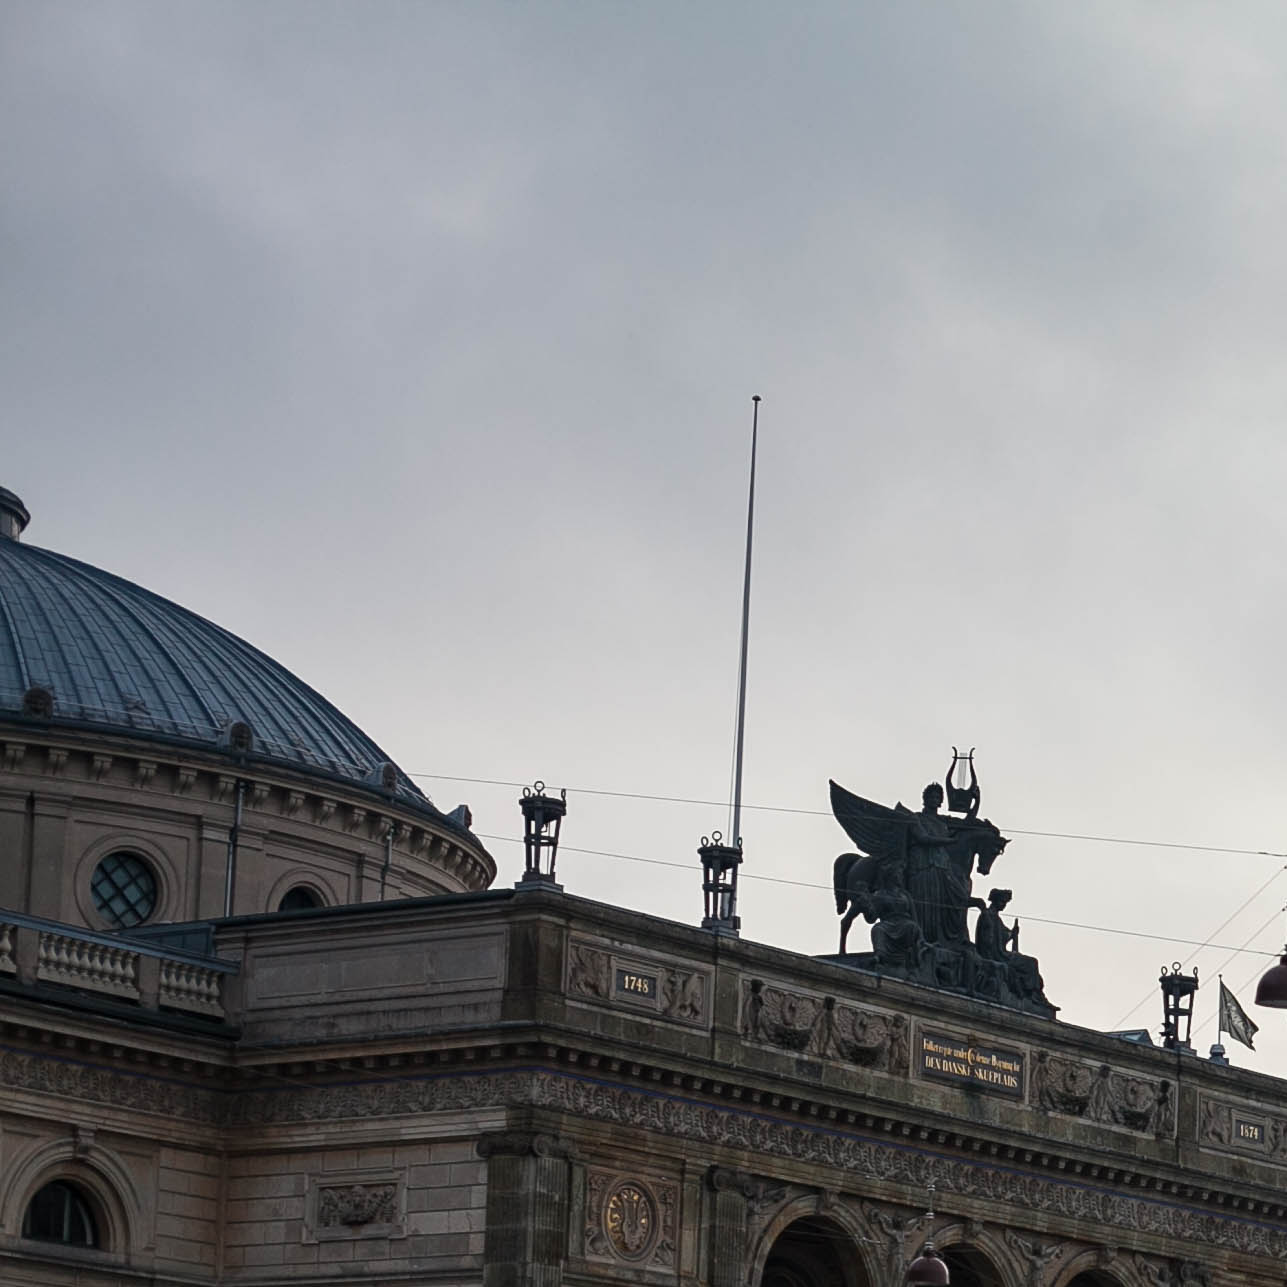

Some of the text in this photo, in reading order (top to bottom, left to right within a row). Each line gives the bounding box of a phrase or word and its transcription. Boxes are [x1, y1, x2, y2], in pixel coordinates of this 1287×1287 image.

[624, 975, 649, 994] 1748
[925, 1055, 1018, 1088] DEN DANSKE SKUEPLADS
